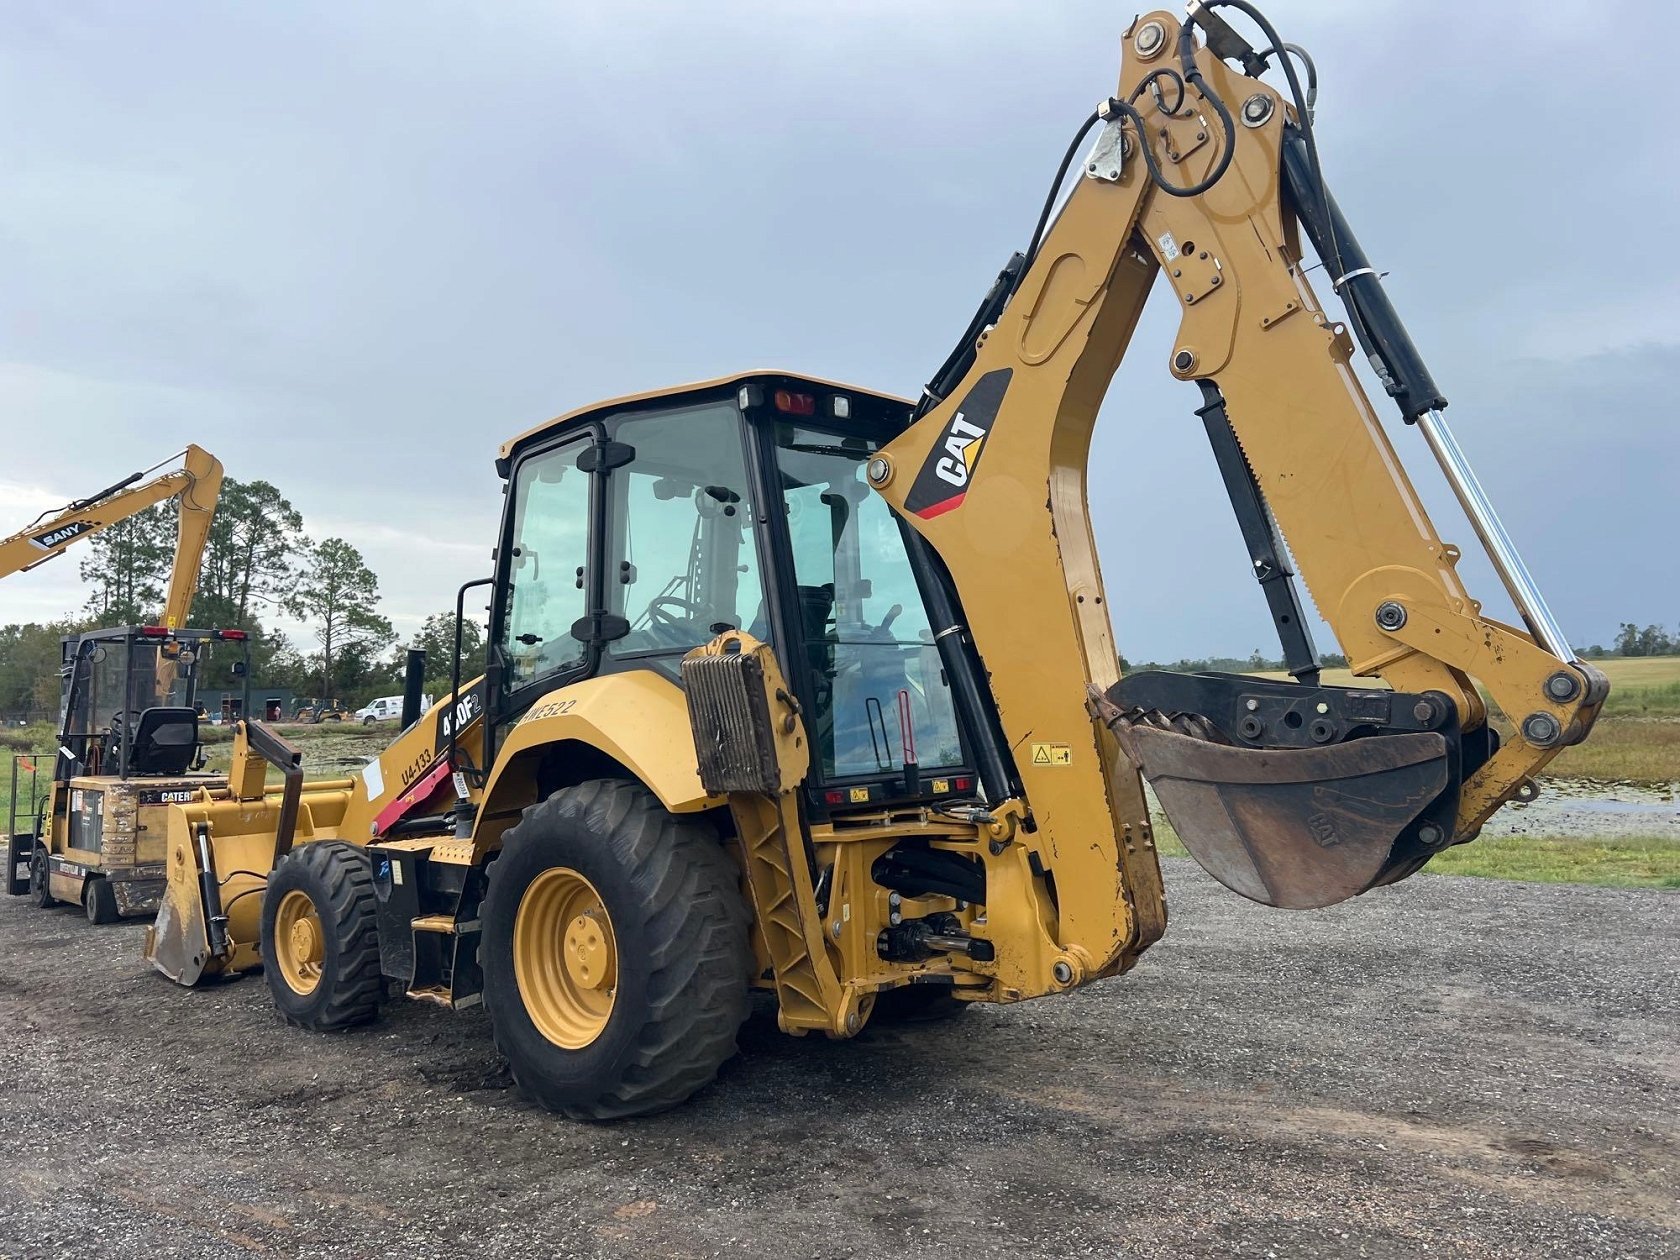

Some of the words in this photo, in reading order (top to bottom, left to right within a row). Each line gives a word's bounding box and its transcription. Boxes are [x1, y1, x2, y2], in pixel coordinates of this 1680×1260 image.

[935, 412, 986, 487] CAT
[43, 523, 79, 546] SANY
[443, 694, 482, 737] 40F2
[401, 748, 432, 786] U4-133
[161, 791, 193, 803] CATER
[1308, 812, 1340, 847] CAT
